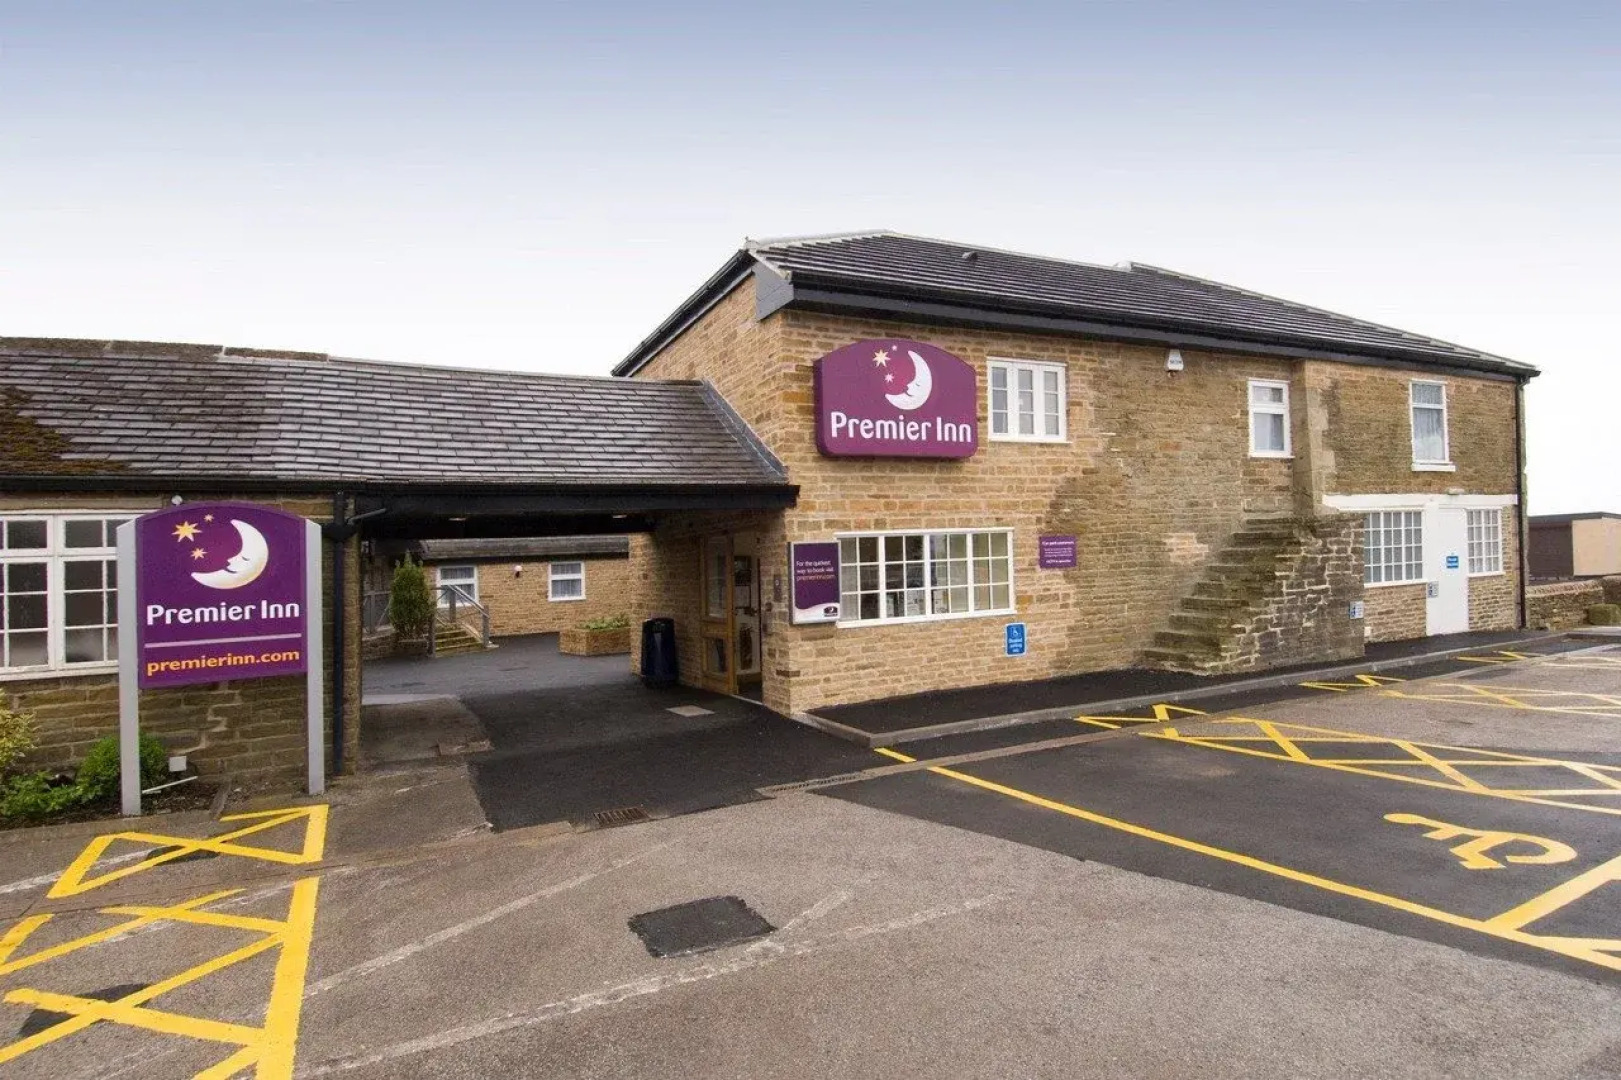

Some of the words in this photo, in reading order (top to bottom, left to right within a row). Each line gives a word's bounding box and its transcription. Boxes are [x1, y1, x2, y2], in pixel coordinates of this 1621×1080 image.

[830, 411, 932, 442] Premier
[936, 416, 972, 443] Inn
[146, 602, 256, 626] Premier
[261, 600, 300, 620] Inn
[146, 649, 300, 676] premierinn.com
